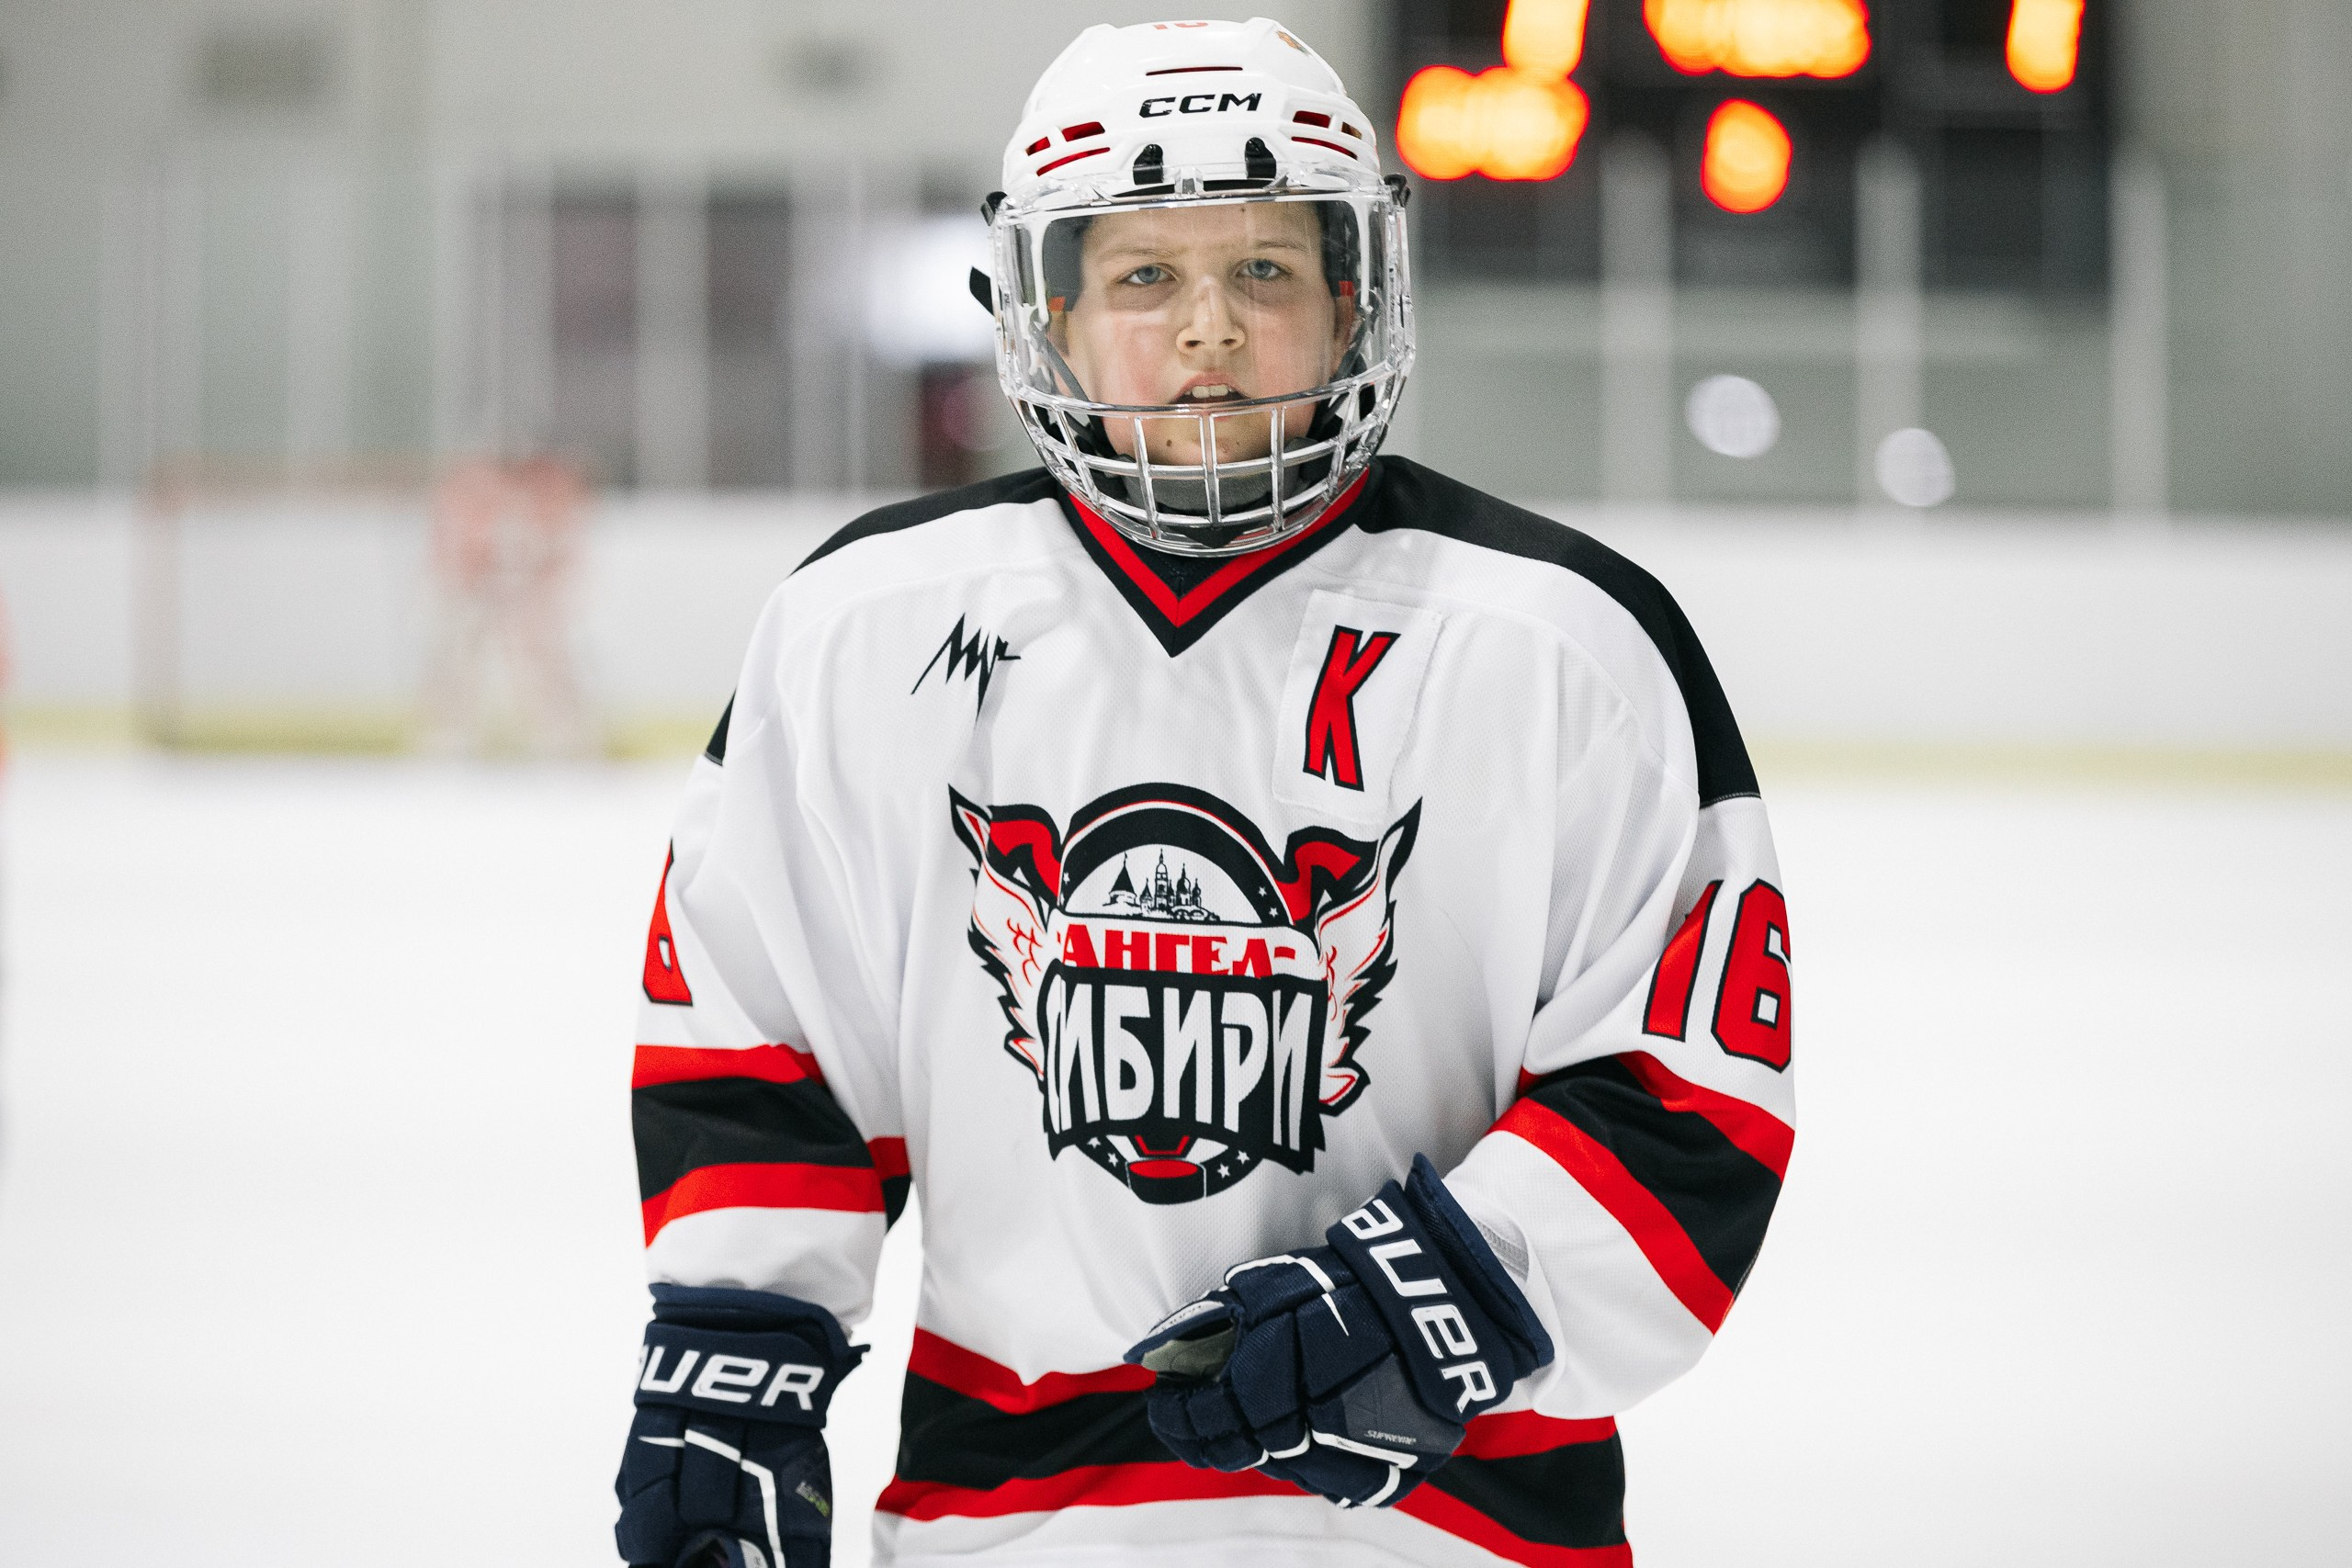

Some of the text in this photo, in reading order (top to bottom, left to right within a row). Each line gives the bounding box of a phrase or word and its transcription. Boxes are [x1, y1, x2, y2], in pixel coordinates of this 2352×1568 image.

[1138, 93, 1262, 118] CCM
[1642, 877, 1792, 1074] 16
[1340, 1196, 1498, 1415] AUER
[638, 1344, 825, 1411] UER
